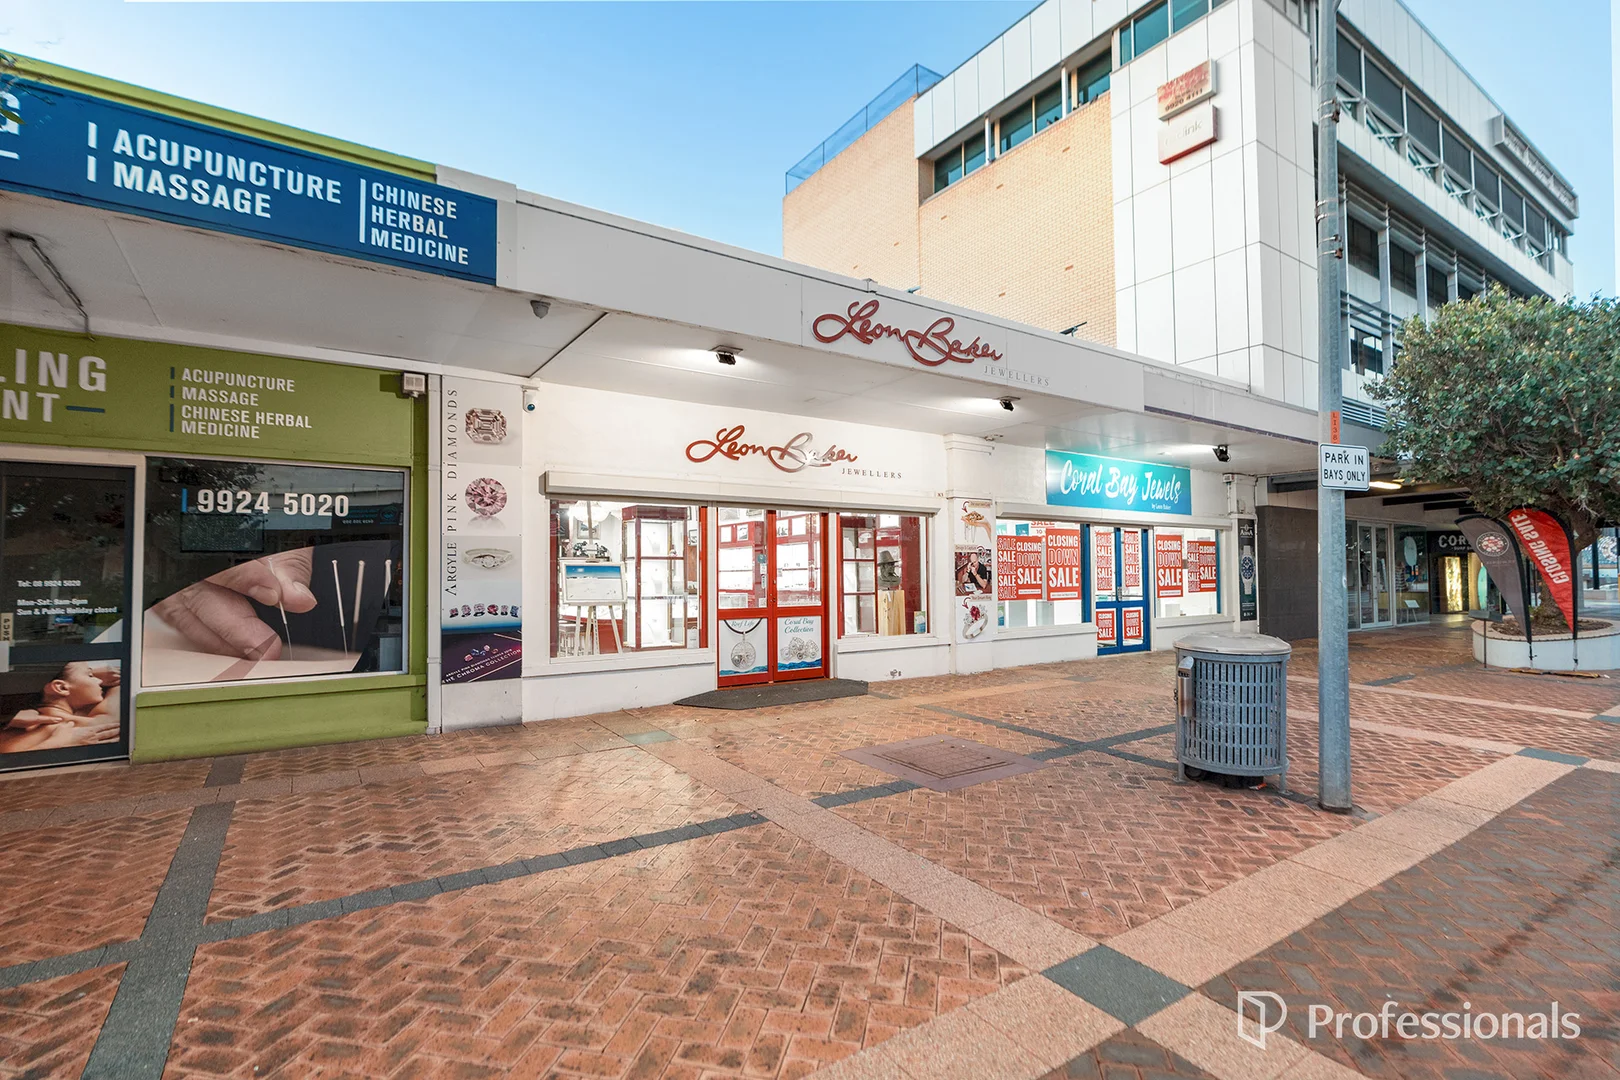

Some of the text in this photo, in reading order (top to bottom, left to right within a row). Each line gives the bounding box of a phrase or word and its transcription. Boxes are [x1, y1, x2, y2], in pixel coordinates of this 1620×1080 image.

[112, 128, 341, 204] ACUPUNCTURE
[113, 160, 271, 218] MASSAGE
[371, 181, 457, 219] CHINESE
[371, 205, 449, 239] HERBAL
[370, 227, 469, 265] MEDICINE
[812, 299, 1003, 367] Leon Baker
[0, 348, 106, 392] ING
[983, 365, 1050, 387] JEWELLERS
[181, 367, 295, 392] ACUPUNCTURE
[182, 386, 259, 406] MASSAGE
[181, 404, 312, 429] CHINESE HERBAL
[181, 420, 260, 439] MEDICINE
[685, 424, 858, 473] Leon Baker
[1325, 452, 1364, 465] PARK IN
[841, 467, 903, 480] JEWELLERS
[1060, 459, 1183, 505] Coral Bay Jewels
[1323, 469, 1366, 481] BAYS ONLY
[445, 388, 458, 597] ARGYLE PINK DIAMONDS
[197, 489, 349, 517] 9924 5020
[1016, 541, 1042, 552] CLOSING
[1048, 535, 1078, 547] CLOSING
[1125, 543, 1138, 553] SALE
[1157, 540, 1181, 551] CLOSING
[998, 551, 1016, 562] SALE
[1016, 552, 1042, 567] DOWN
[1048, 548, 1078, 566] DOWN
[1097, 546, 1112, 556] SALE
[1157, 551, 1181, 568] DOWN
[1188, 553, 1199, 562] SALE
[1017, 568, 1042, 585] SALE
[1049, 567, 1079, 588] SALE
[1098, 567, 1112, 578] SALE
[1126, 564, 1139, 574] SALE
[1158, 568, 1182, 587] SALE
[1188, 572, 1199, 582] SALE
[1200, 566, 1216, 580] SALE
[998, 575, 1016, 587] SALE
[784, 618, 801, 626] Coral
[784, 626, 814, 634] Collection
[1098, 627, 1112, 638] SALE
[1126, 626, 1139, 636] SALE
[456, 665, 485, 678] CHROMA
[485, 649, 521, 666] COLLECTION
